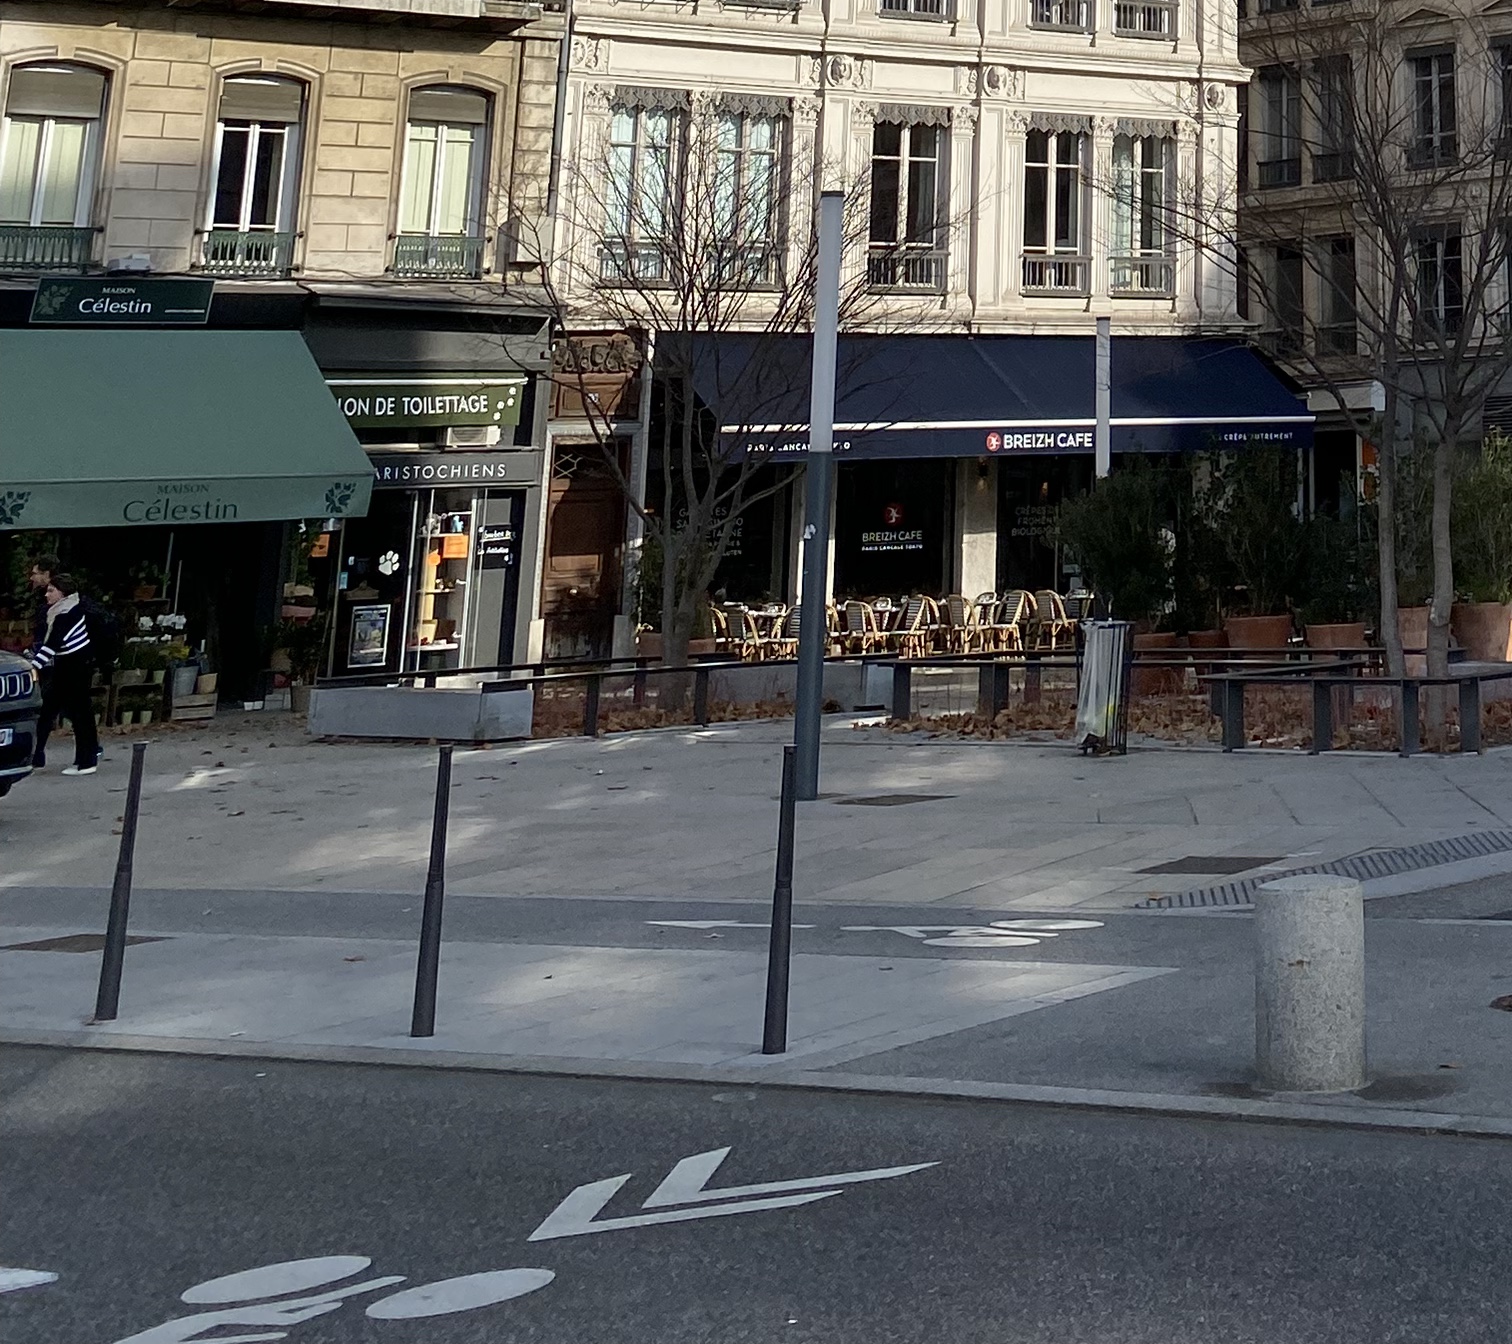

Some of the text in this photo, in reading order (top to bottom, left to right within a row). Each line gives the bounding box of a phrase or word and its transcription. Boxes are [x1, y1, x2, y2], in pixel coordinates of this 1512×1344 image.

[78, 298, 151, 313] Célestin
[375, 397, 396, 416] DE
[402, 395, 488, 414] TOILETTAGE
[1003, 433, 1093, 449] BREIZH CAFE
[157, 483, 209, 494] MAISON
[123, 498, 238, 522] Célestin
[862, 530, 923, 542] BREIZH CAFE
